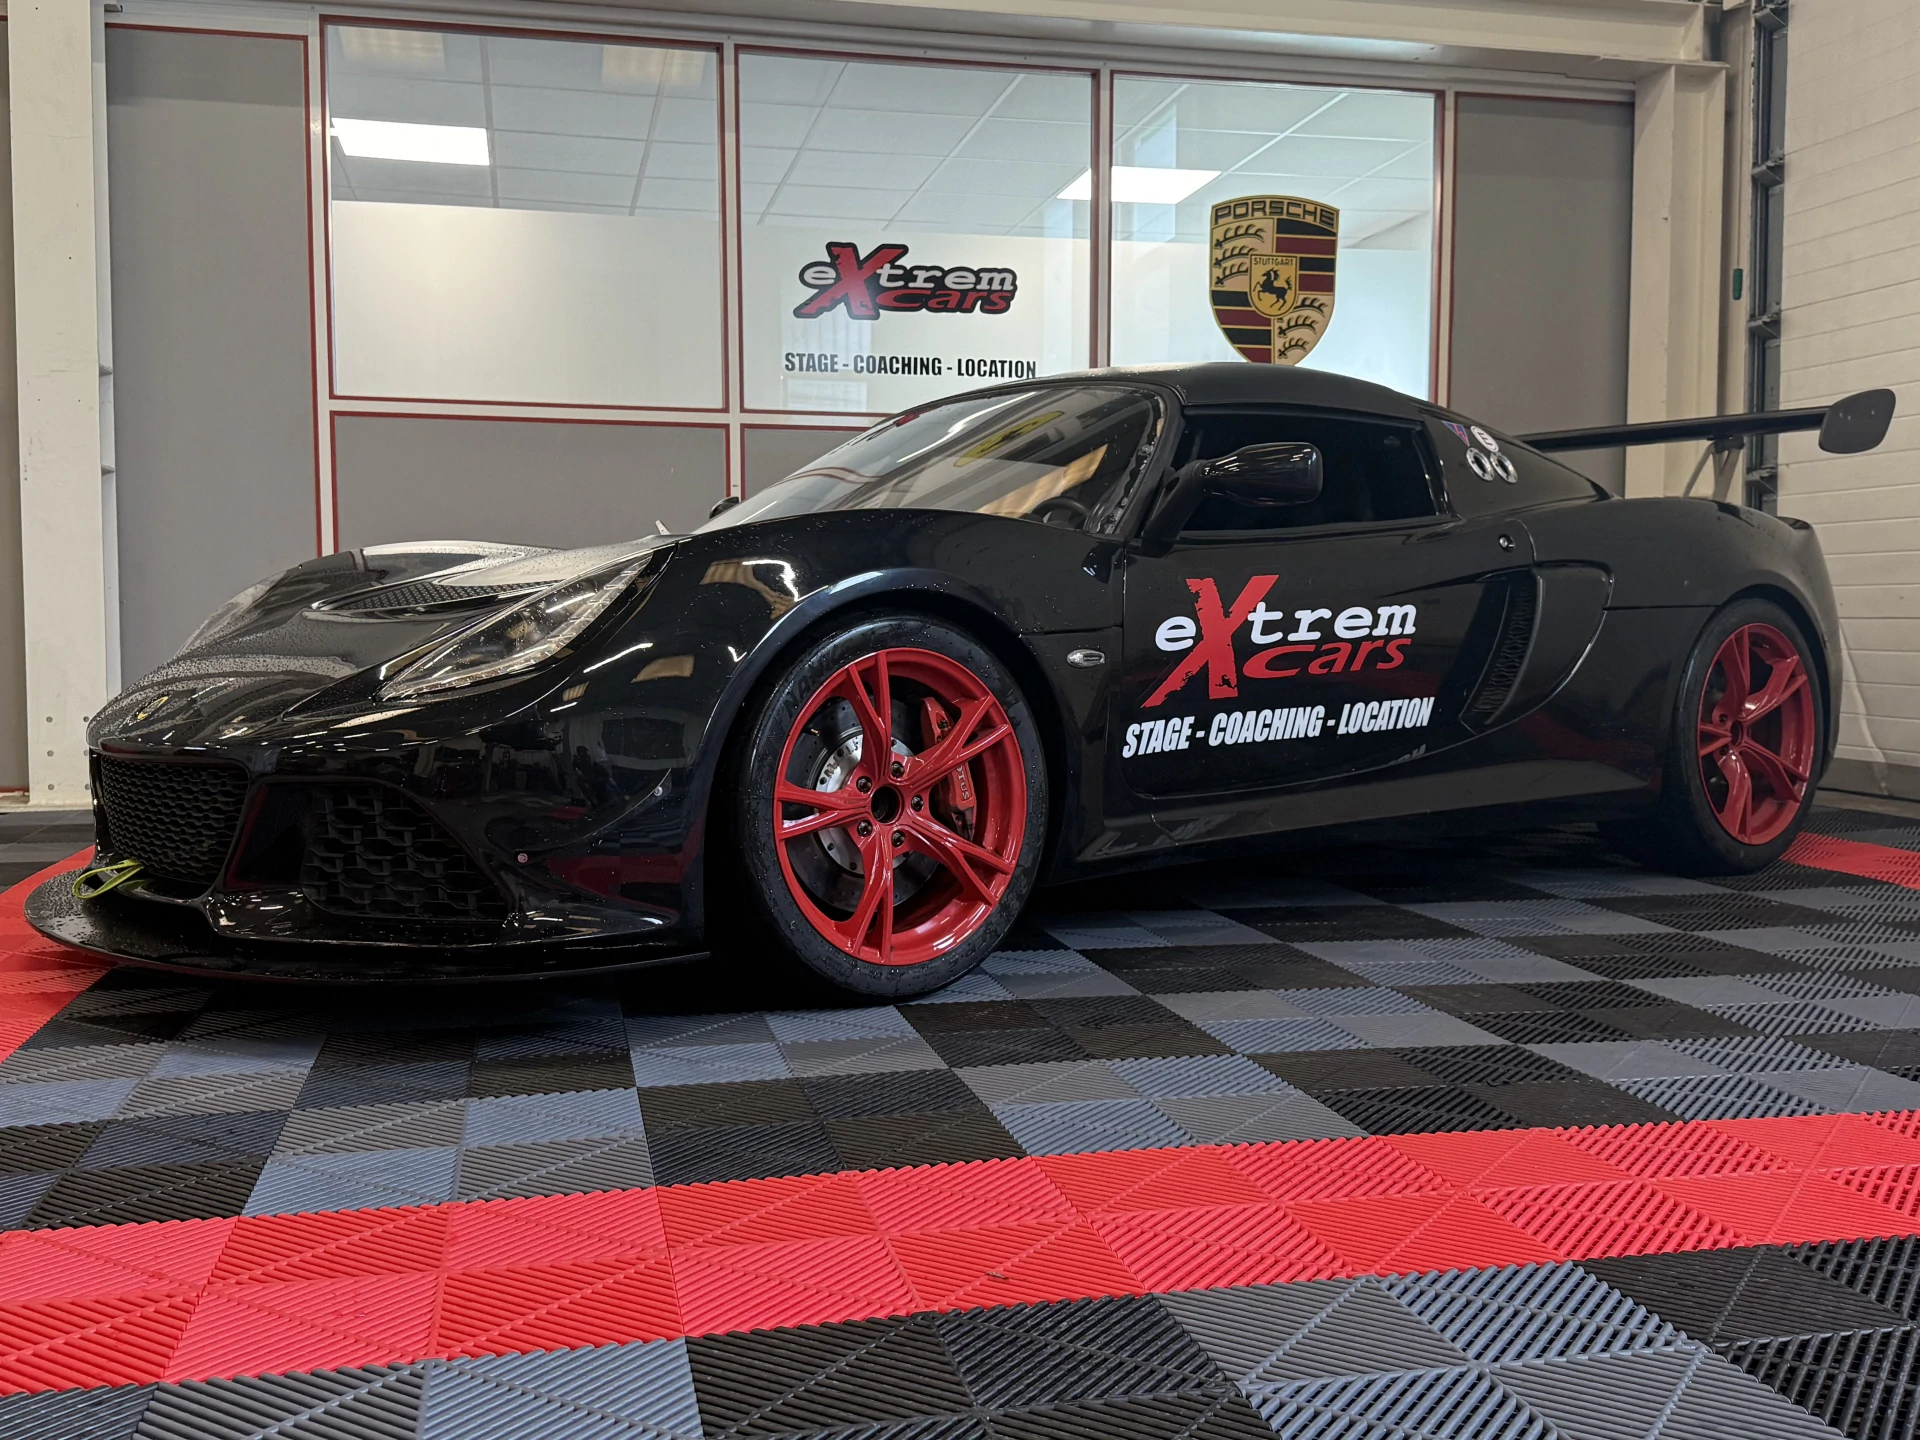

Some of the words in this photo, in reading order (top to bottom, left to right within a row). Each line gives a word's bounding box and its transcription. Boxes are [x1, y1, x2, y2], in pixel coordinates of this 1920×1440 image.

[1214, 200, 1336, 229] PORSCHE
[1253, 257, 1294, 267] STUTTGART
[799, 245, 1015, 318] eXtrem
[875, 288, 1013, 312] cars
[784, 352, 838, 373] STAGE
[853, 354, 942, 376] COACHING
[957, 358, 1037, 379] LOCATION
[1140, 574, 1417, 709] eXtrem
[1242, 638, 1412, 679] cars
[1122, 716, 1195, 759] STAGE
[1208, 705, 1325, 747] COACHING
[1337, 697, 1435, 735] LOCATION
